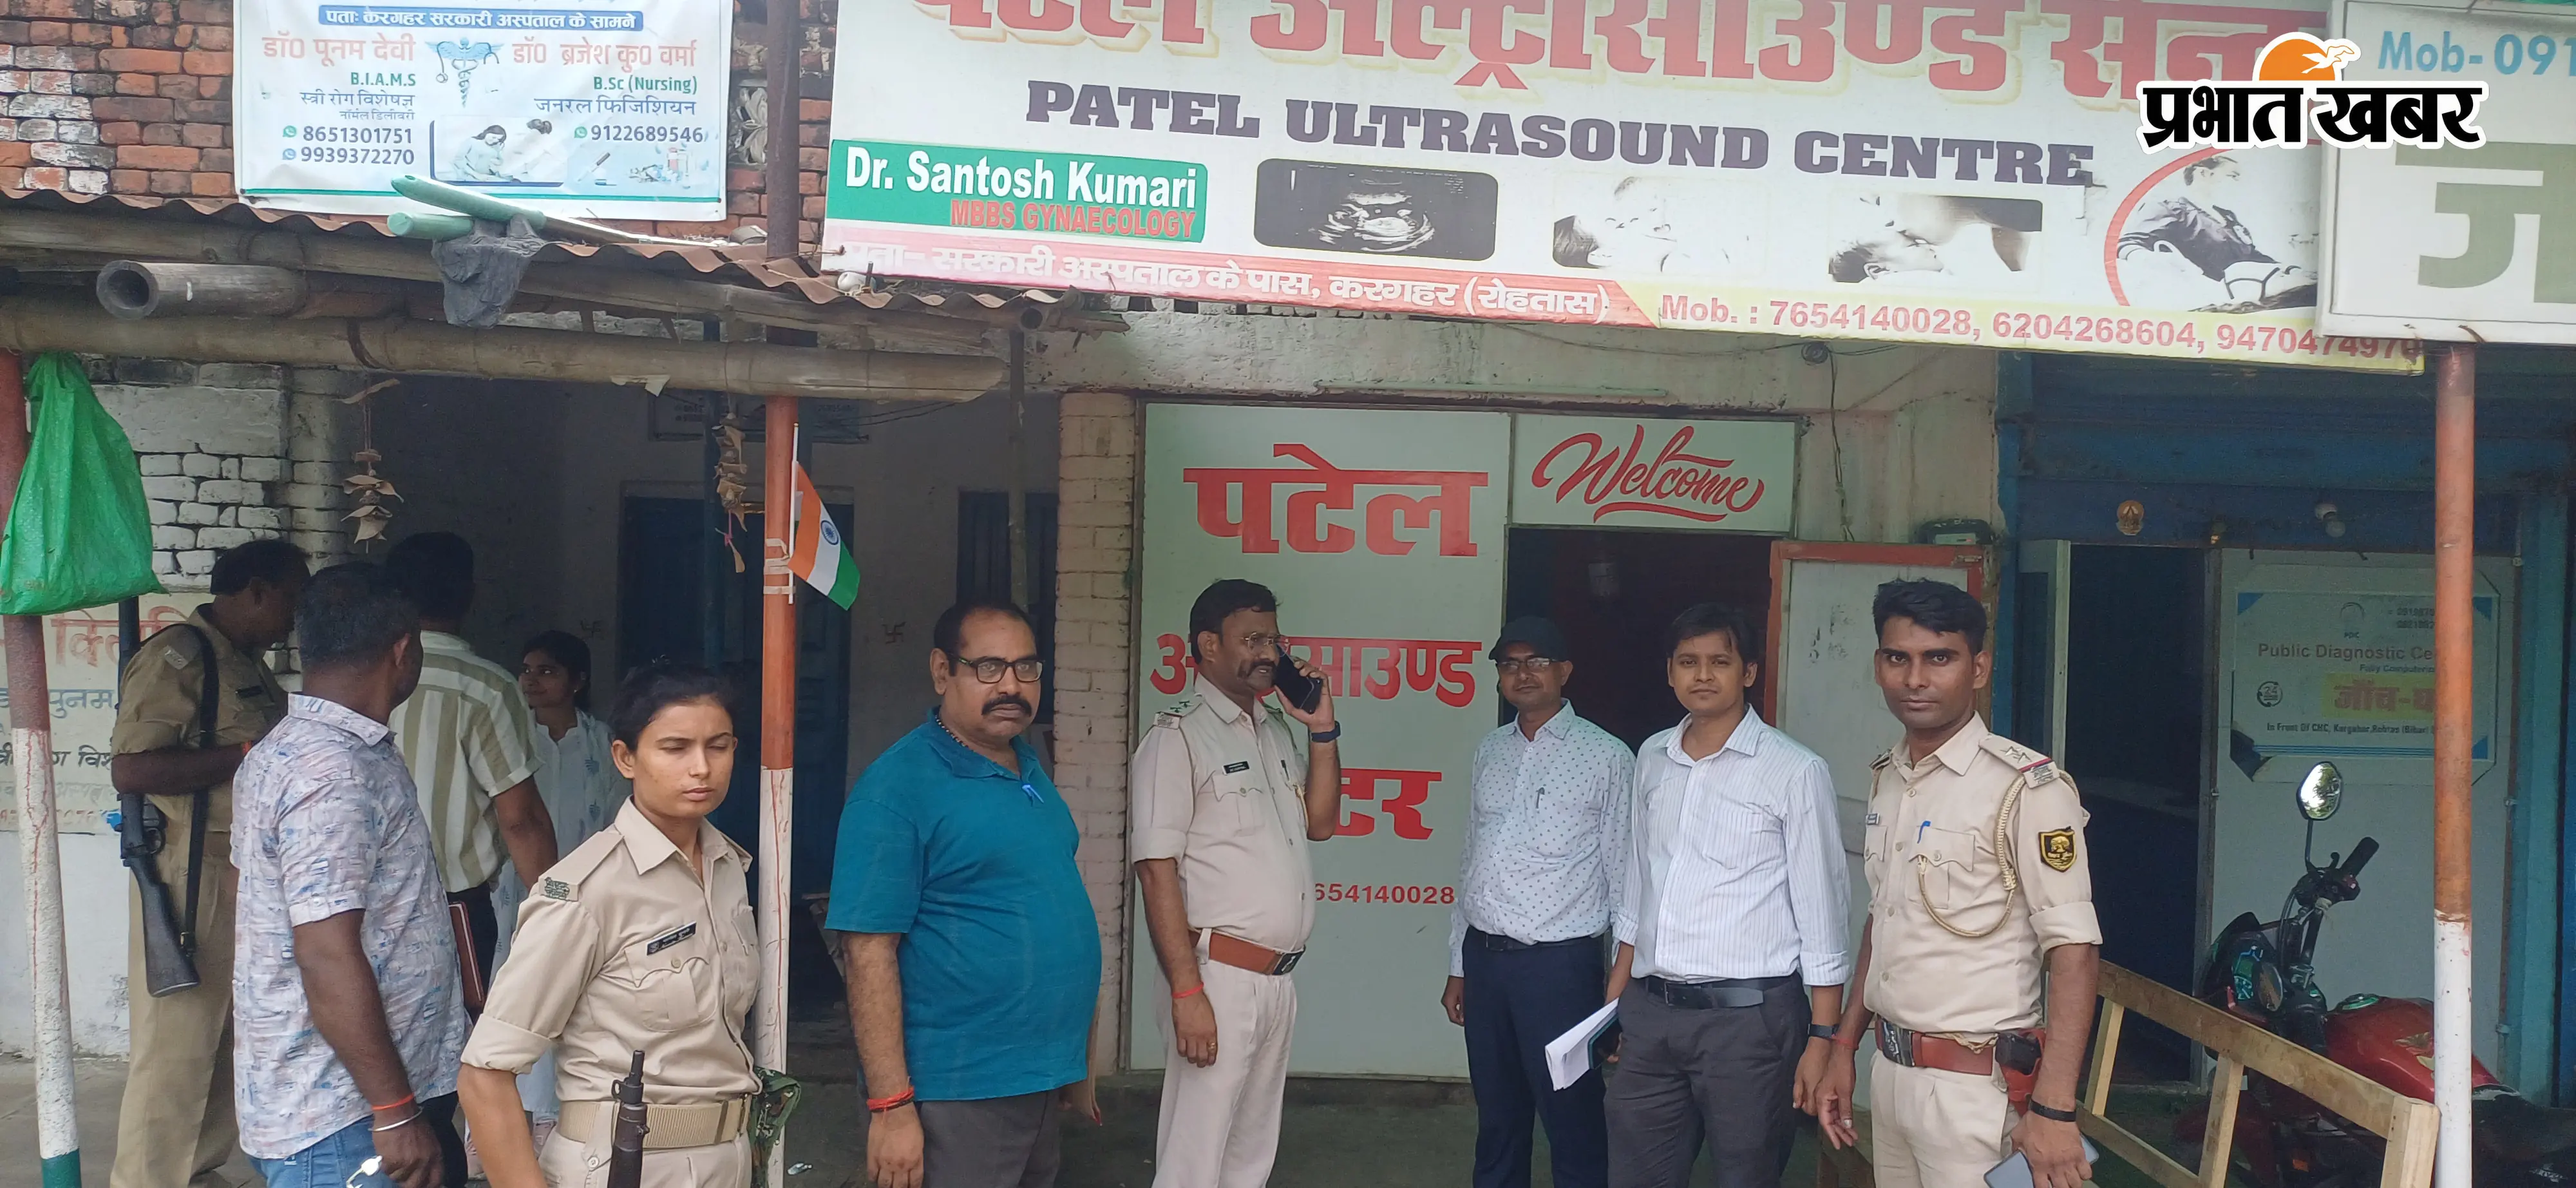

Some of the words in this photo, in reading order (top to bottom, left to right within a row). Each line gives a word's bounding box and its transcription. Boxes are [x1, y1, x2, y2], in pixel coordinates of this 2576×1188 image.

[430, 10, 492, 26] सरकारी
[496, 13, 566, 28] अस्पताल
[569, 12, 587, 28] के
[590, 13, 636, 28] सामने
[313, 39, 366, 66] पूनम
[372, 32, 416, 61] देवी
[560, 37, 611, 65] ब्रजेश
[658, 39, 697, 66] वर्मा
[351, 72, 416, 86] B.I.A.M.S
[594, 76, 623, 90] B.Sc
[629, 75, 697, 95] (Nursing)
[299, 88, 325, 105] स्त्री
[328, 89, 354, 105] रोग
[357, 90, 415, 108] विशेषज्ञ
[534, 98, 592, 113] जनरल
[596, 95, 697, 116] फिजिशियन
[303, 126, 412, 144] 8651301751
[591, 125, 703, 143] 9122689546
[1027, 81, 1260, 138] PATEL
[1285, 99, 1769, 169] ULTRASOUND
[1794, 131, 2094, 189] CENTRE
[301, 146, 415, 165] 9939372270
[846, 146, 893, 189] Dr.
[907, 150, 1054, 200] Santosh
[1067, 160, 1197, 208] Kumari
[950, 200, 1016, 229] MBBS
[1022, 204, 1197, 238] GYNAECOLOGY
[932, 245, 1056, 277] सरकारी
[1058, 256, 1204, 288] अस्पताल
[1206, 259, 1243, 289] के
[1246, 269, 1320, 298] पास,
[1329, 275, 1460, 307] करगहर
[1463, 276, 1611, 324] (रोहतास)
[1770, 300, 1982, 341] 7654140028,
[1993, 312, 2205, 353] 6204268604,
[1531, 424, 1765, 518] Welcome
[1183, 443, 1488, 557] पटेल
[2258, 643, 2311, 658] Public
[2316, 644, 2405, 662] Diagnostic
[1315, 883, 1455, 905] 654140028
